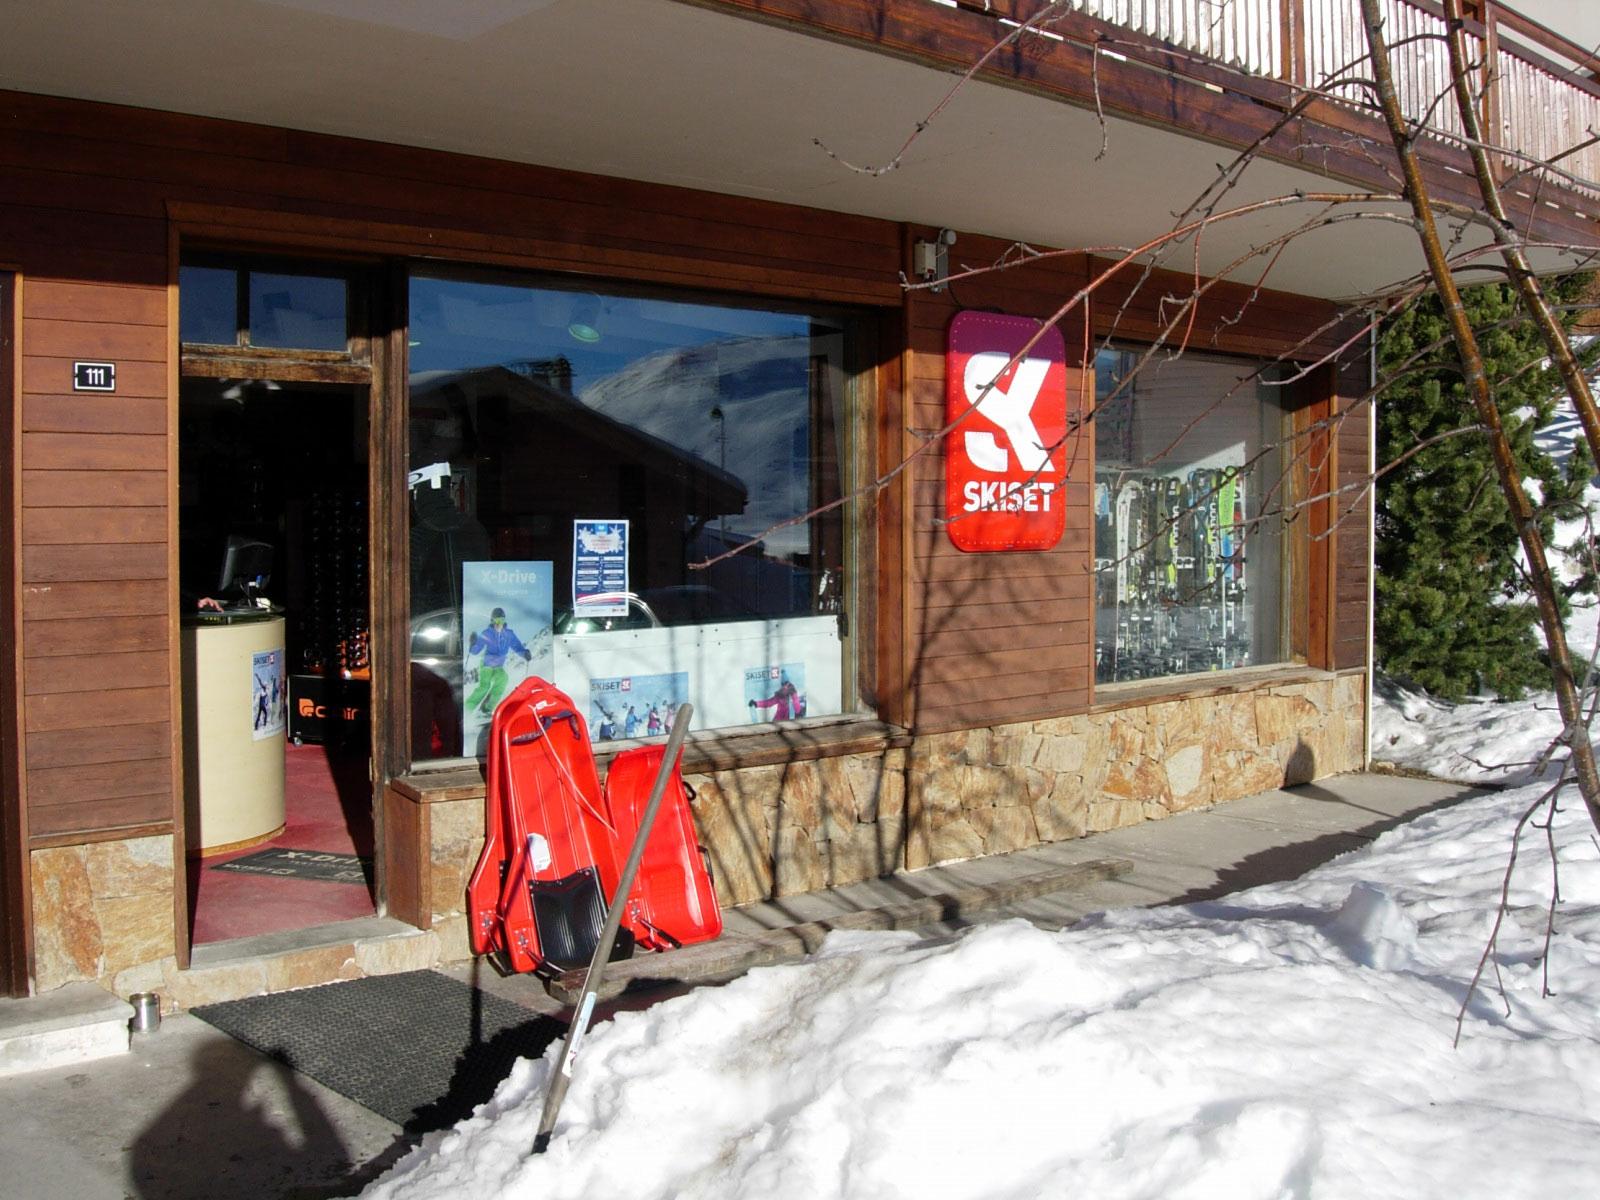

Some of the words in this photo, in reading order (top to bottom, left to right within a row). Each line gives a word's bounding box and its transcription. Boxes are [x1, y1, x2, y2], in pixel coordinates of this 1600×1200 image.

[85, 368, 105, 385] 111
[963, 481, 1055, 512] SKISET
[481, 569, 537, 584] X-Drive
[745, 671, 770, 680] SKISET
[591, 681, 621, 691] SKISET
